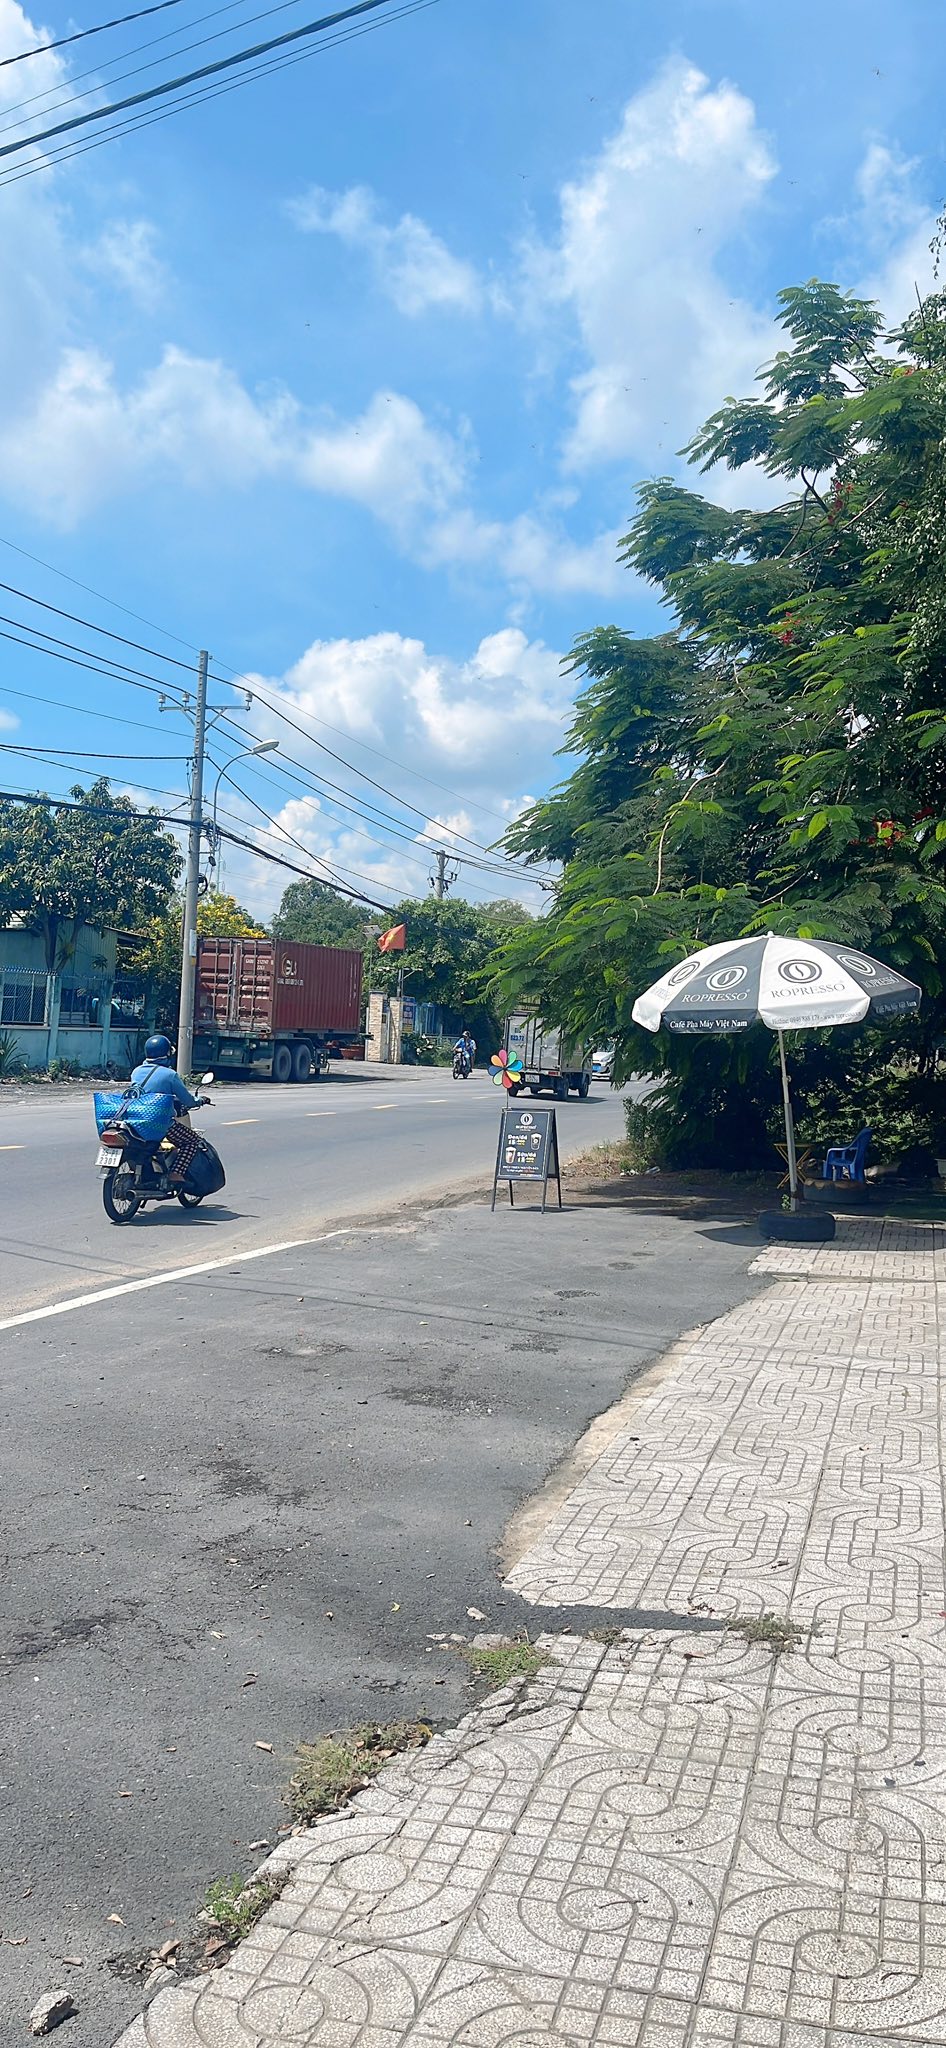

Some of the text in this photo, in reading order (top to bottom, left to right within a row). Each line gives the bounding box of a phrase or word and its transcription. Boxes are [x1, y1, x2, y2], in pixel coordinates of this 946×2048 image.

[681, 991, 748, 1003] ROPRESSO
[770, 983, 846, 999] ROPRESSO
[669, 1018, 748, 1029] Café Pha Máy Việt Nam
